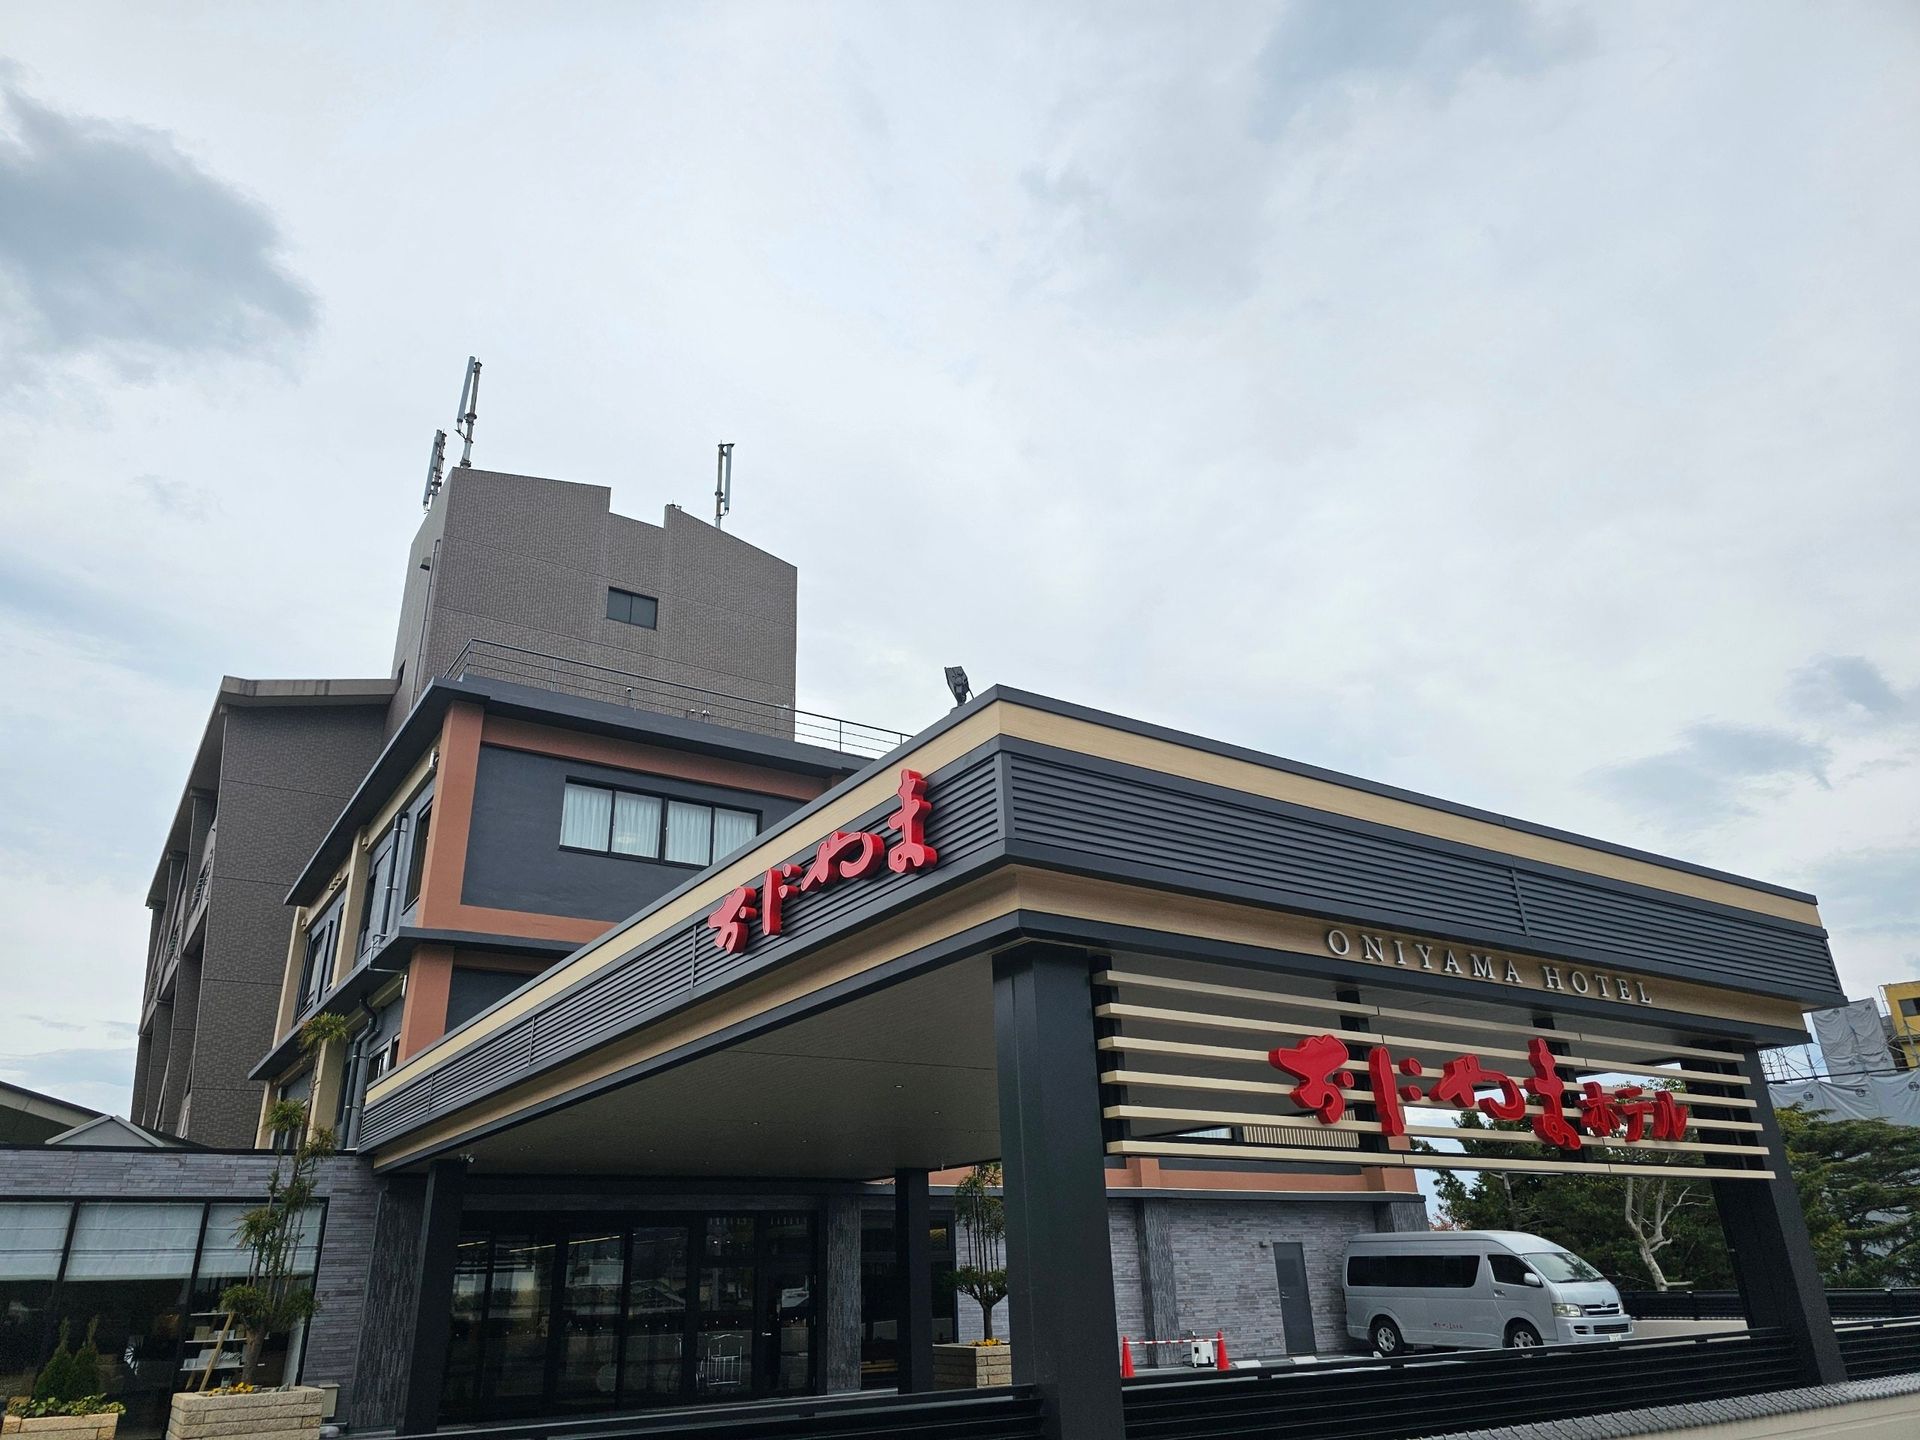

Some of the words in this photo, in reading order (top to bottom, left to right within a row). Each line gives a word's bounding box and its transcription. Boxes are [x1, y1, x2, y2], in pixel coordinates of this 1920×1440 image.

[707, 768, 938, 954] おにやま
[1327, 929, 1522, 984] ONIYAMA
[1543, 966, 1652, 1004] HOTEL
